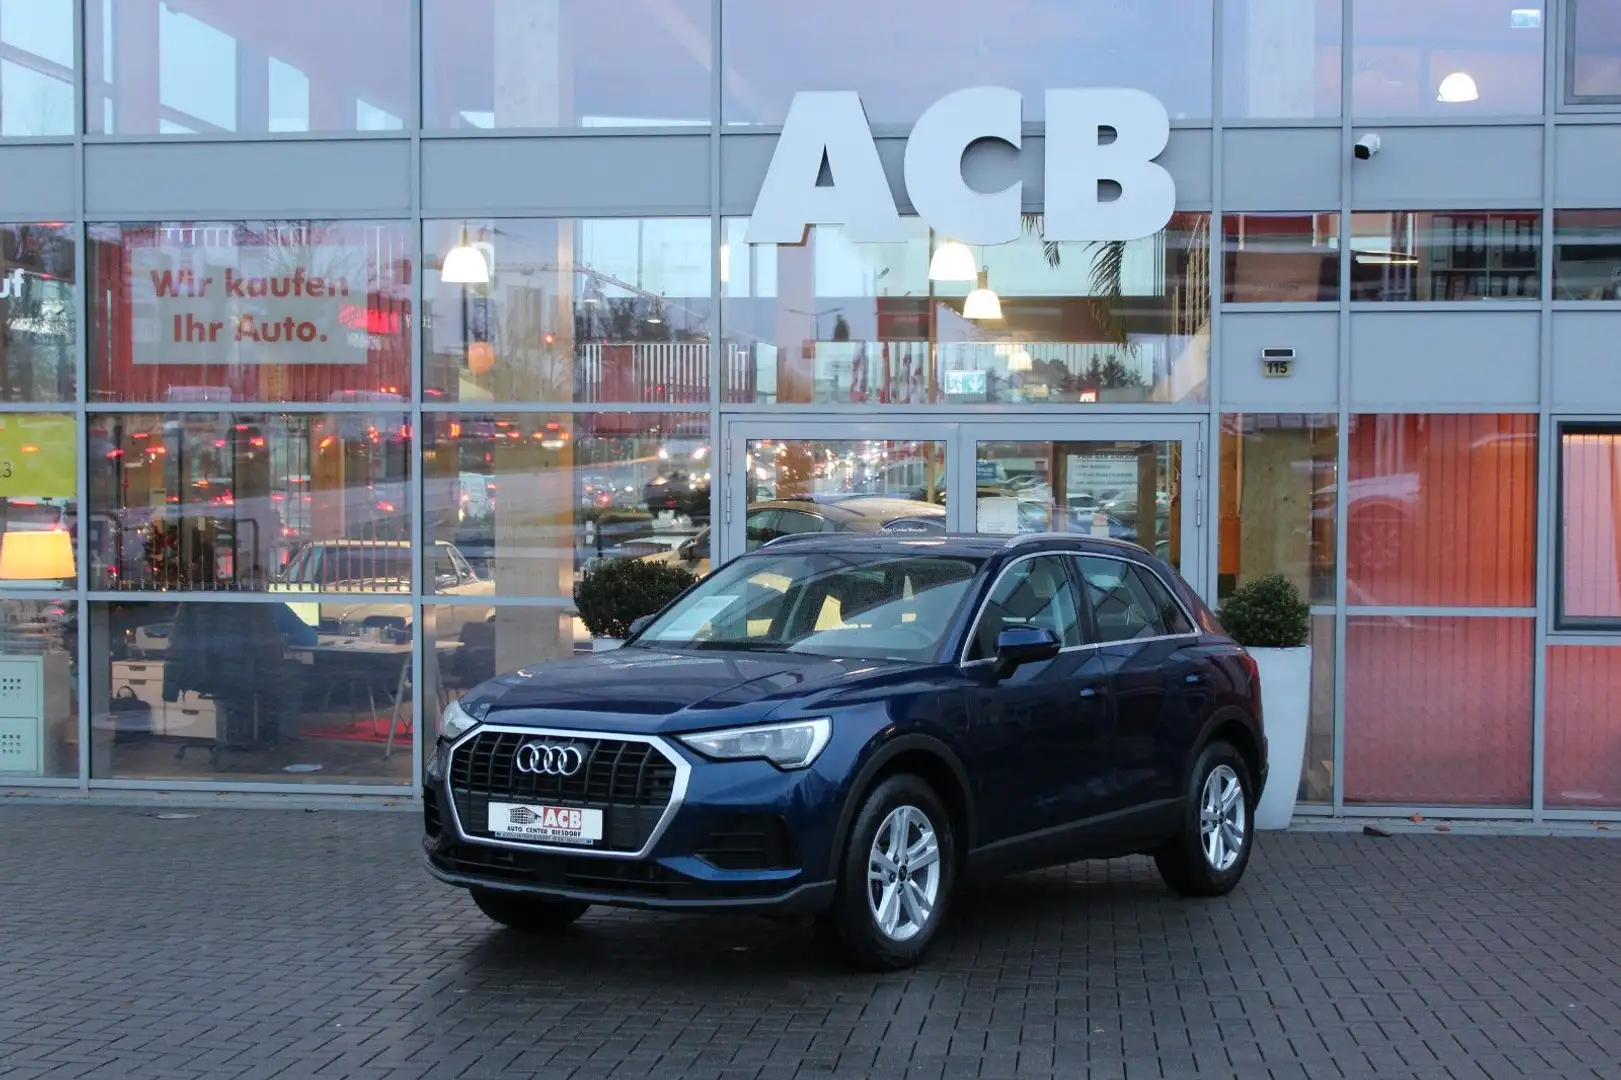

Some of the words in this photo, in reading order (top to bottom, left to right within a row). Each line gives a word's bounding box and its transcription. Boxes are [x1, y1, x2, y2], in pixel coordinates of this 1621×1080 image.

[743, 86, 1177, 245] ACB
[151, 270, 213, 297] Wir
[225, 268, 348, 297] kaufen
[173, 313, 223, 342] Ihr
[235, 313, 327, 342] Auto.
[1267, 361, 1288, 374] 115
[543, 808, 581, 828] ACB
[551, 829, 581, 837] BIESDORF
